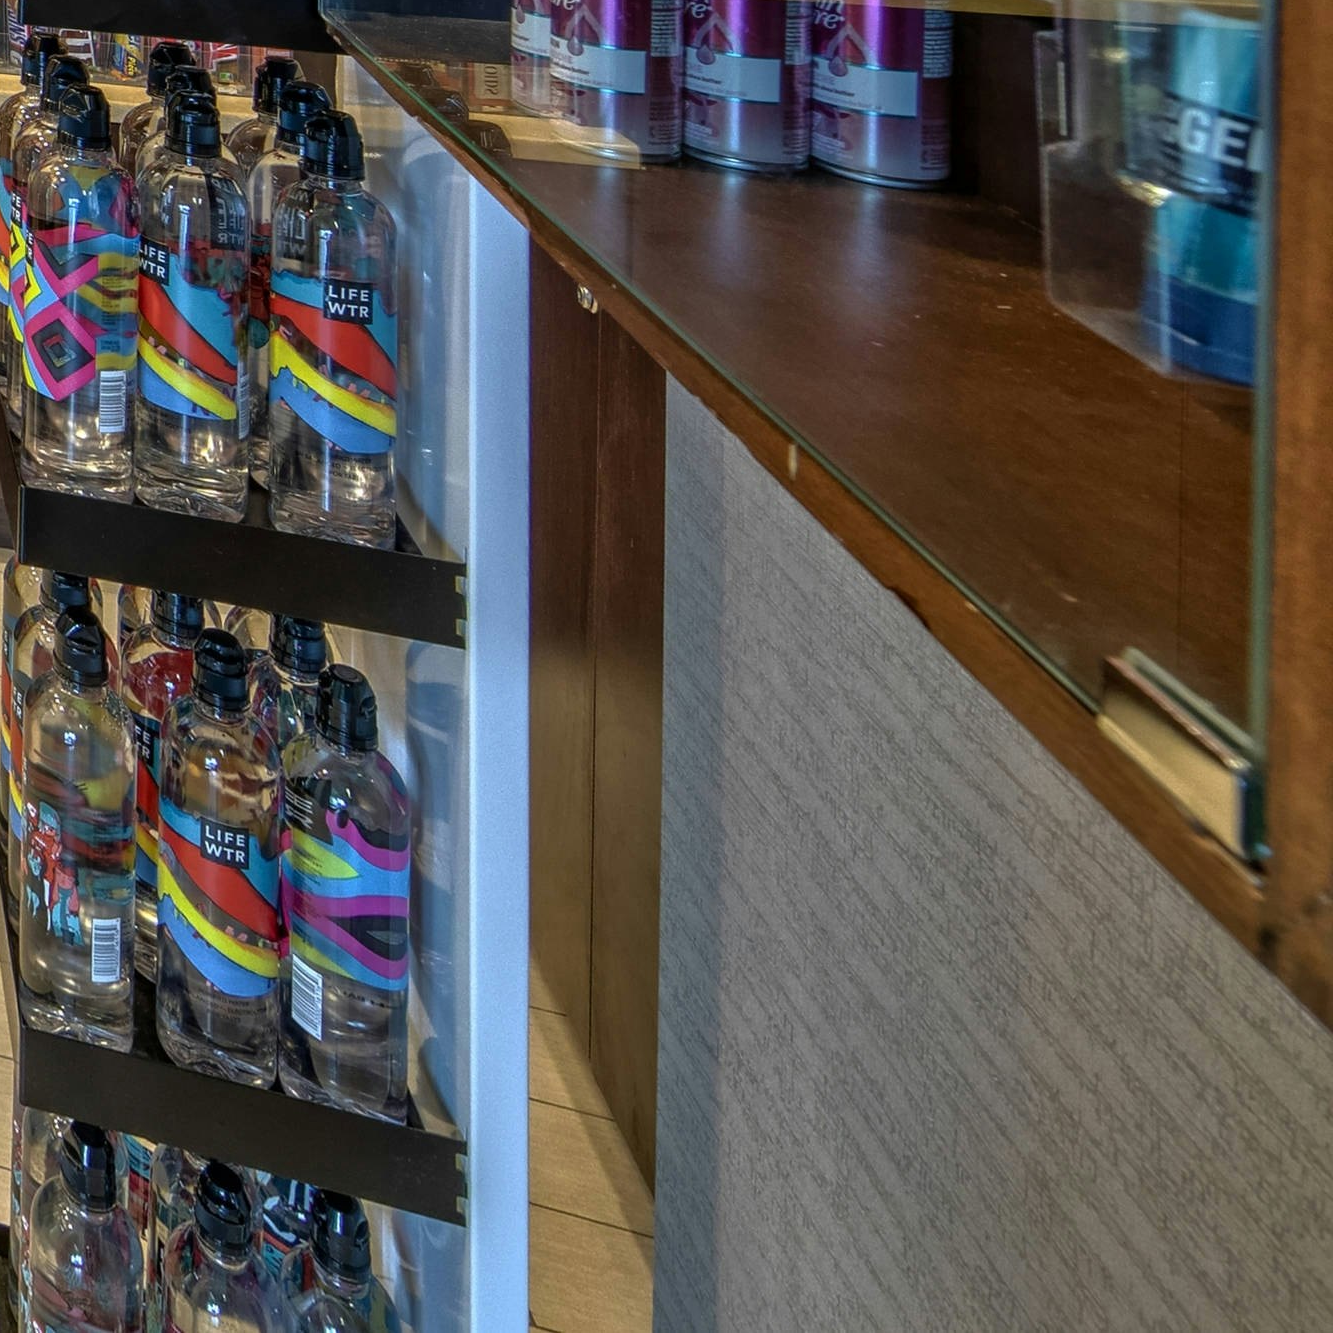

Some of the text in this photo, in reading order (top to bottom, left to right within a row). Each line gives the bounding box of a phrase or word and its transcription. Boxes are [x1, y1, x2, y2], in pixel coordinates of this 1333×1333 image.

[139, 243, 168, 266] LIFE
[139, 258, 167, 280] WTR
[328, 284, 370, 303] LIFE
[327, 301, 370, 320] WTR
[204, 825, 246, 848] LIFE
[203, 839, 246, 864] WTR
